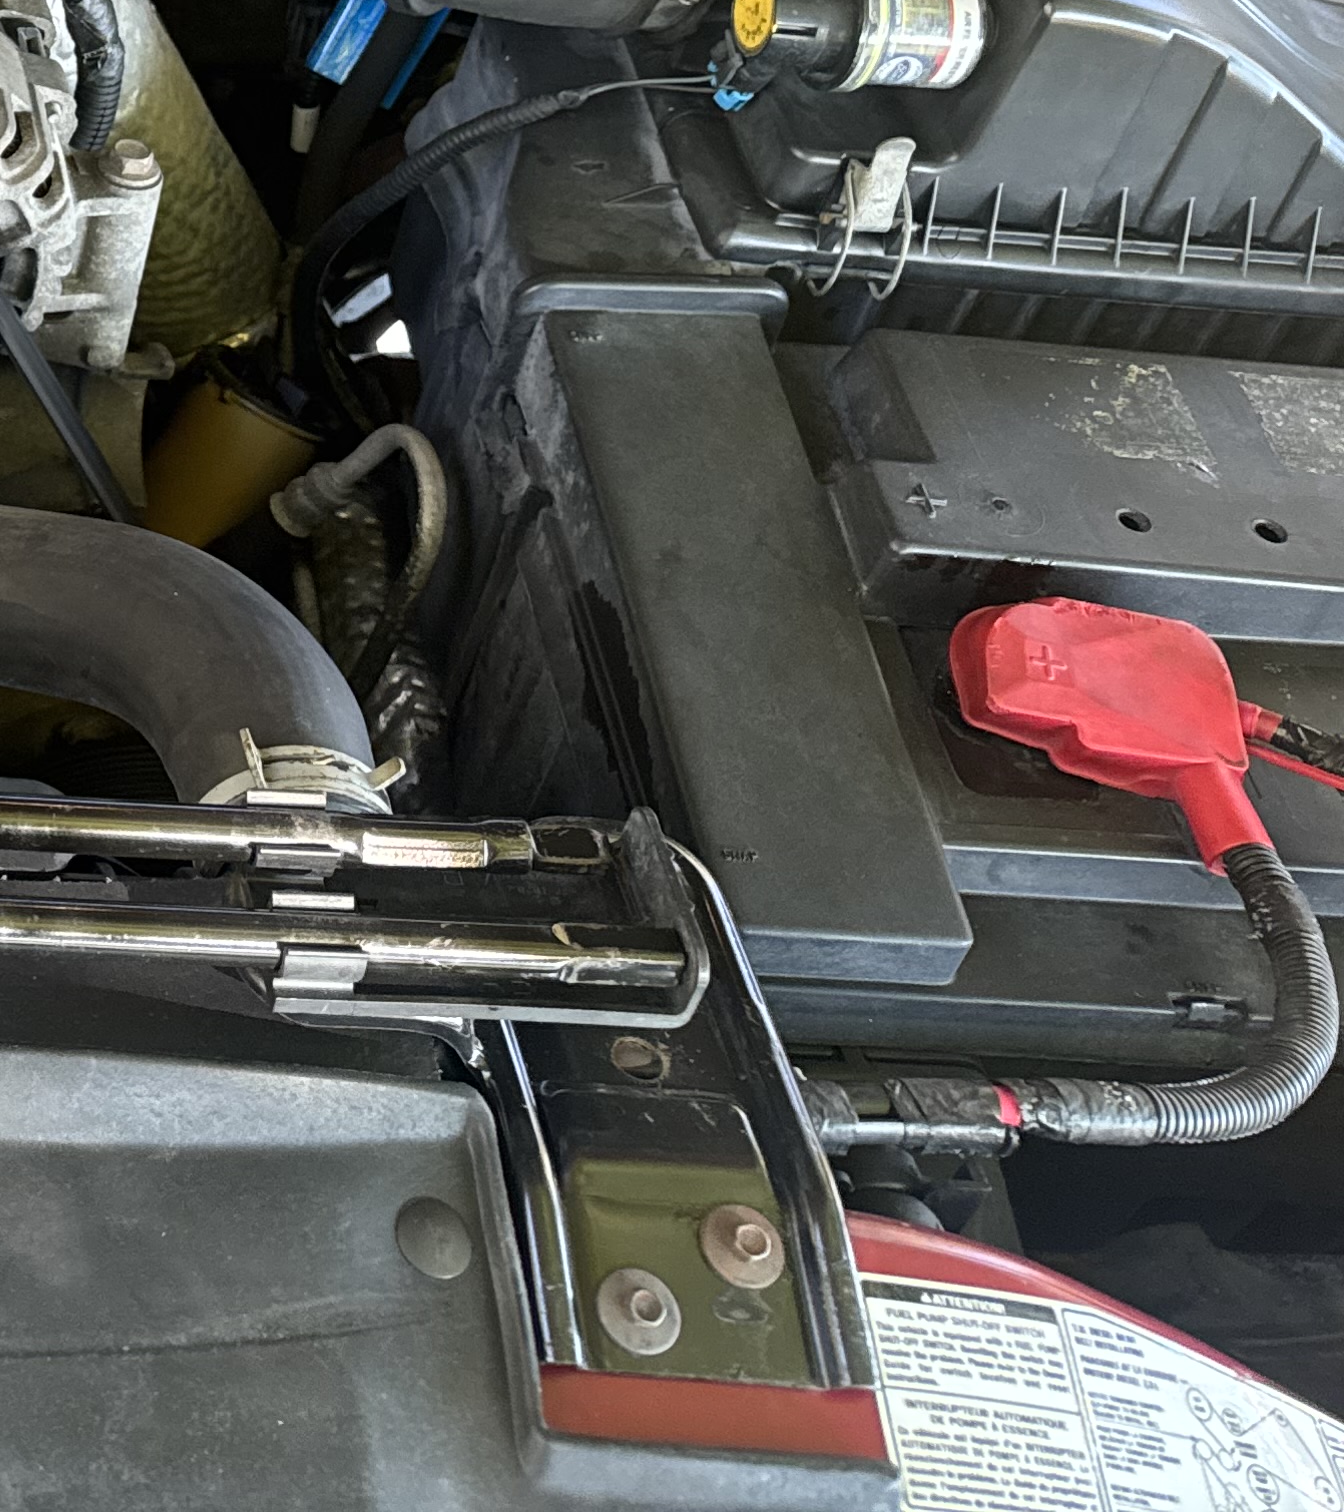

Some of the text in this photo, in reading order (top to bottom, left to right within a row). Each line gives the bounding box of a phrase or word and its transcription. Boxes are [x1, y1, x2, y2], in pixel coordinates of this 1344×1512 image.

[885, 1307, 914, 1321] FUEL
[917, 1311, 948, 1324] PUMP
[1004, 1324, 1046, 1339] SWITCH
